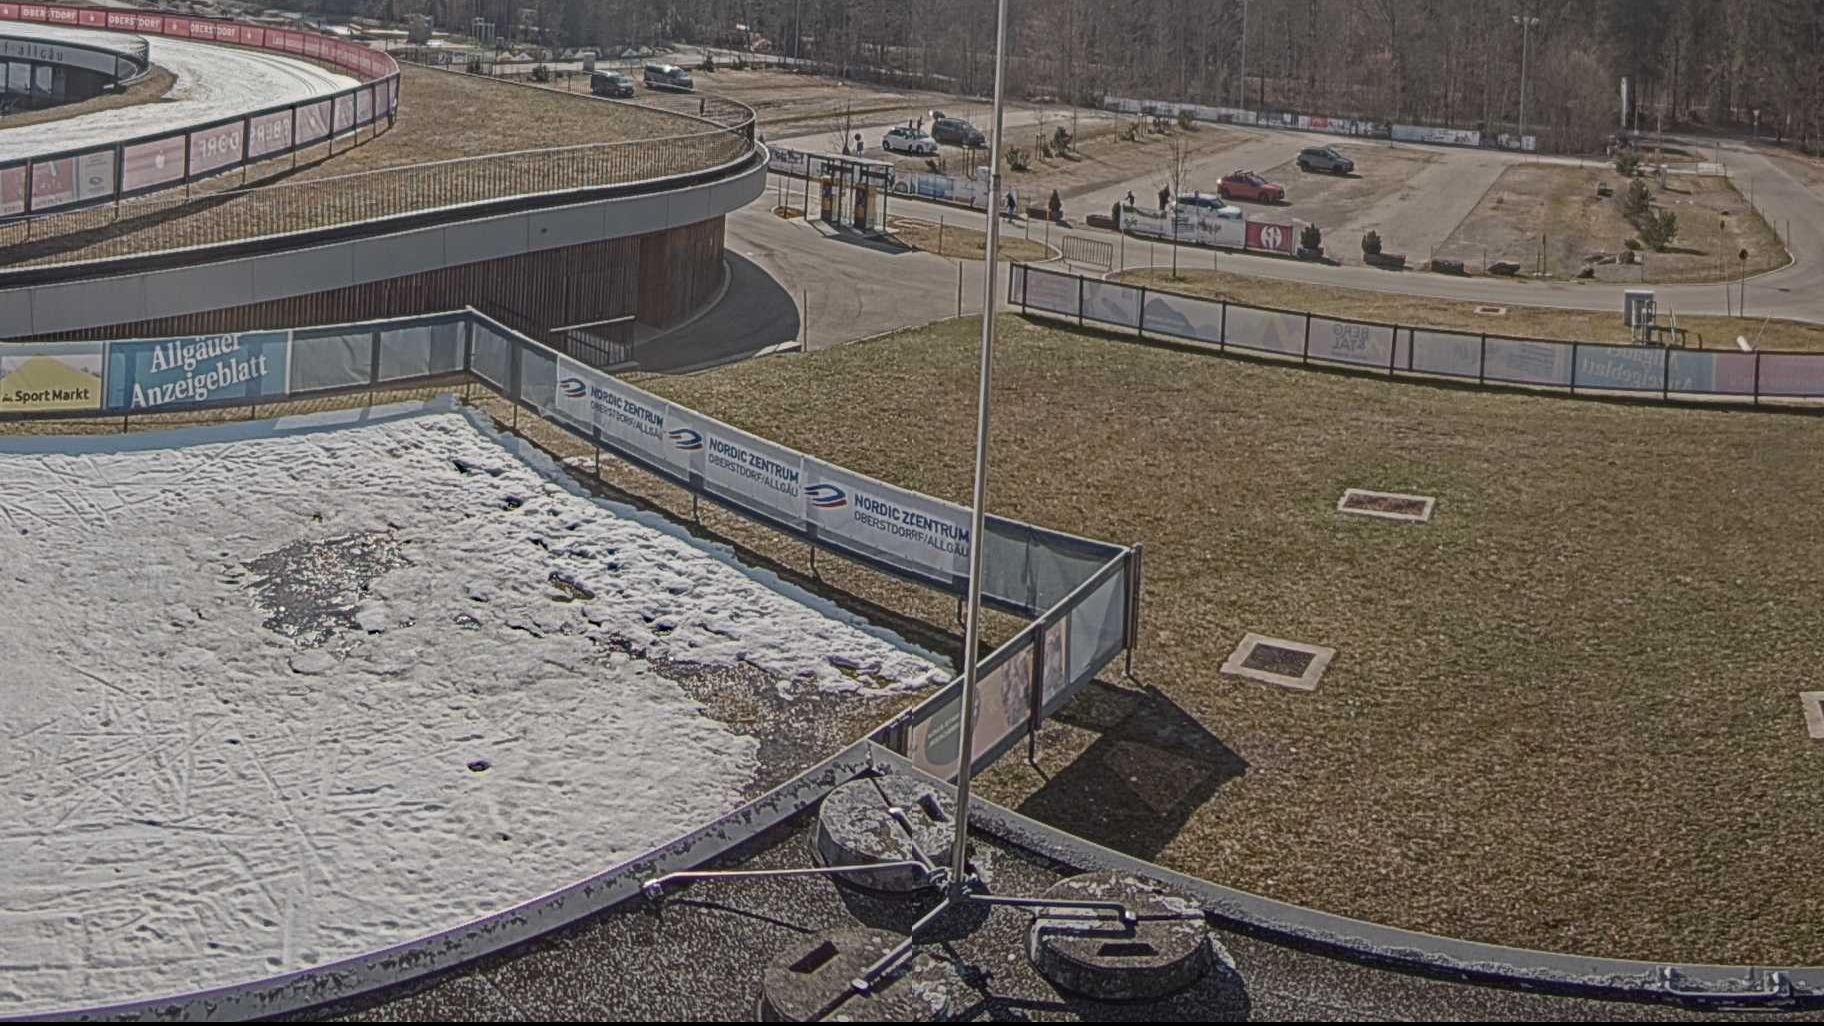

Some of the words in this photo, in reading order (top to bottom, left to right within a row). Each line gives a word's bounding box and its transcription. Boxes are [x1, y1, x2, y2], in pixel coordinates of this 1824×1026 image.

[23, 7, 76, 19] OBERTDORF
[150, 333, 243, 372] Allgäuer
[15, 390, 50, 403] Sport
[52, 388, 89, 401] Markt
[130, 354, 268, 408] Anzeigeblatt
[591, 386, 624, 410] NORDIC
[624, 400, 664, 427] ZENTRUM
[709, 437, 748, 462] NORDIC
[748, 454, 800, 484] ZENTRUM
[854, 493, 900, 521] NORDIC
